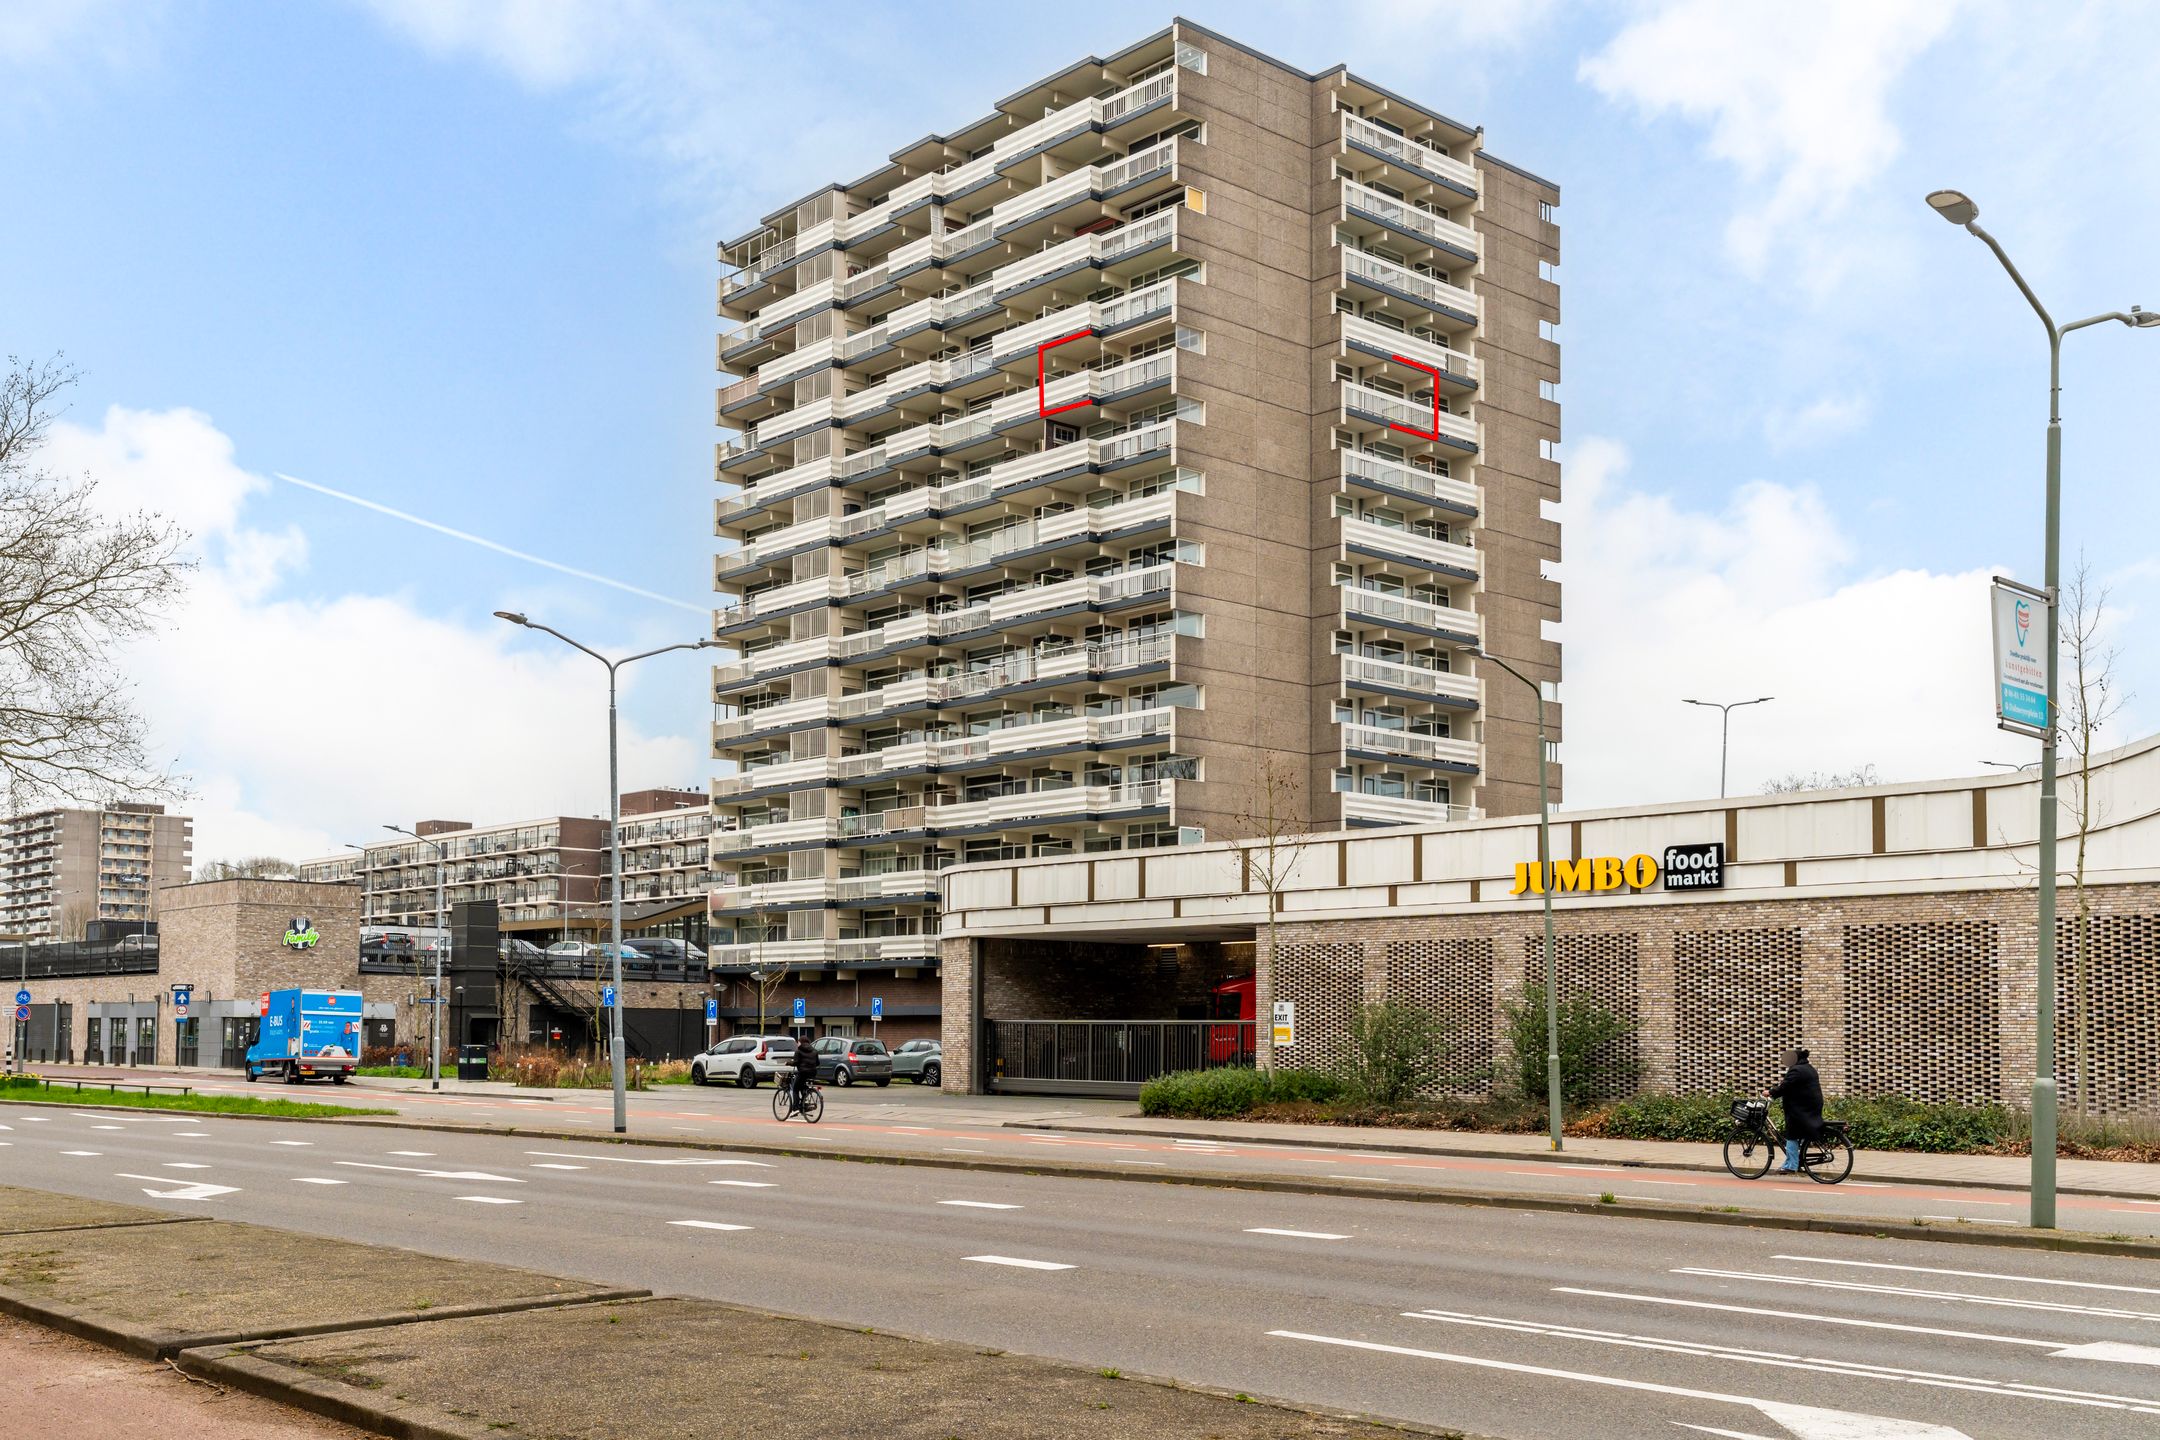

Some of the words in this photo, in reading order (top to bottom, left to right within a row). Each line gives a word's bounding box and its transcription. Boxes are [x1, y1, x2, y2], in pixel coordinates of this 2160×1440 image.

[1665, 846, 1719, 870] food
[1509, 854, 1658, 895] JUMBO
[1667, 870, 1719, 887] markt
[283, 927, 320, 947] Family
[606, 989, 613, 998] P
[709, 1001, 715, 1010] P
[796, 1001, 803, 1010] P
[874, 999, 880, 1008] P
[270, 1015, 283, 1027] E-BUS
